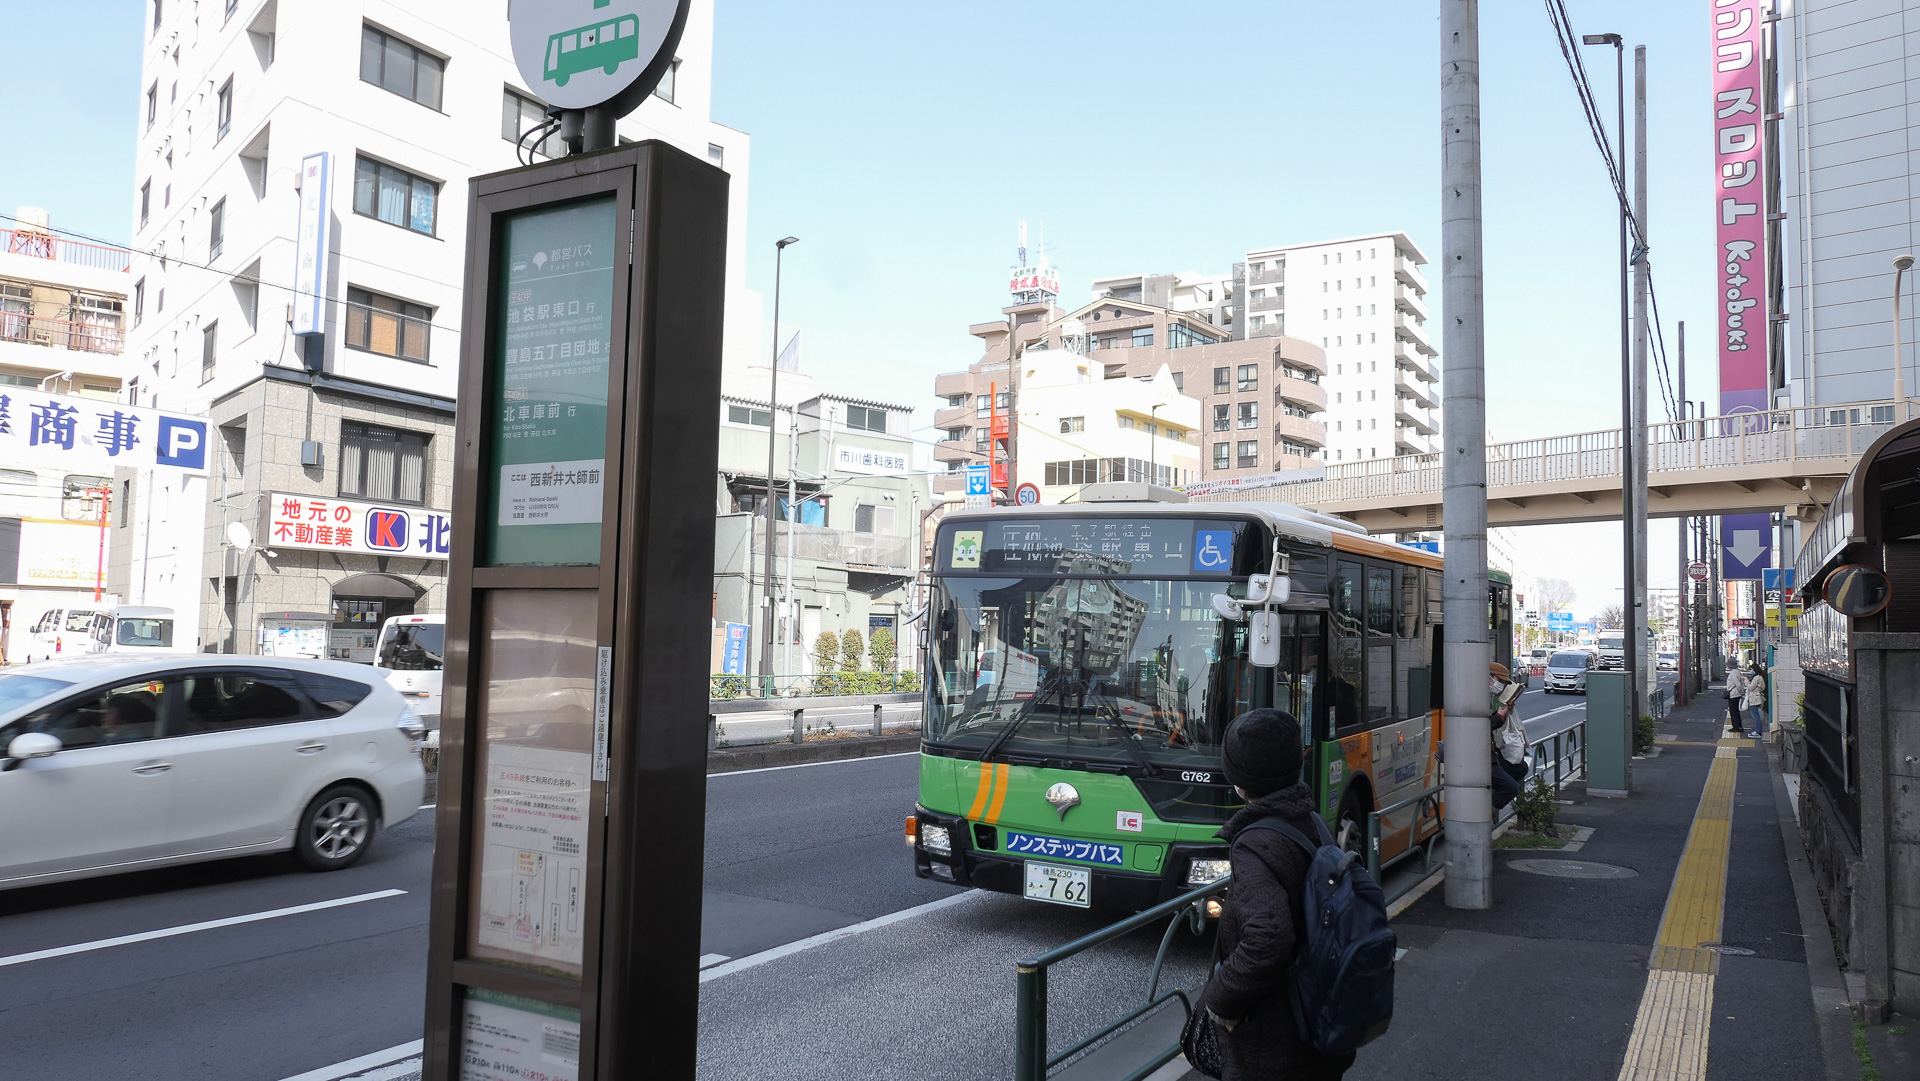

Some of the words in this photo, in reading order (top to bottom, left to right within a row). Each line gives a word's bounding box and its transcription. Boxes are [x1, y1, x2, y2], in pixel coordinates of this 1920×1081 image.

[1714, 0, 1754, 73] ンコ
[1717, 87, 1759, 225] スロット
[551, 244, 593, 262] 都営バス
[1724, 240, 1758, 351] Kotobuki
[508, 300, 580, 323] 池袋駅東口
[586, 302, 596, 314] 行
[507, 338, 600, 364] 豊島五丁目団地
[503, 402, 561, 422] 北車庫前
[567, 405, 576, 417] 行
[0, 394, 141, 457] 商事
[169, 426, 199, 458] P
[840, 450, 905, 470] 市川歯科医院
[511, 474, 526, 482] ここは
[530, 469, 600, 488] 西新井大師前
[1020, 490, 1035, 504] 50
[282, 498, 352, 524] 地元の
[274, 521, 353, 547] 不動産業
[376, 511, 401, 548] K
[1181, 771, 1211, 783] G762
[1008, 834, 1123, 864] ノンステップバス
